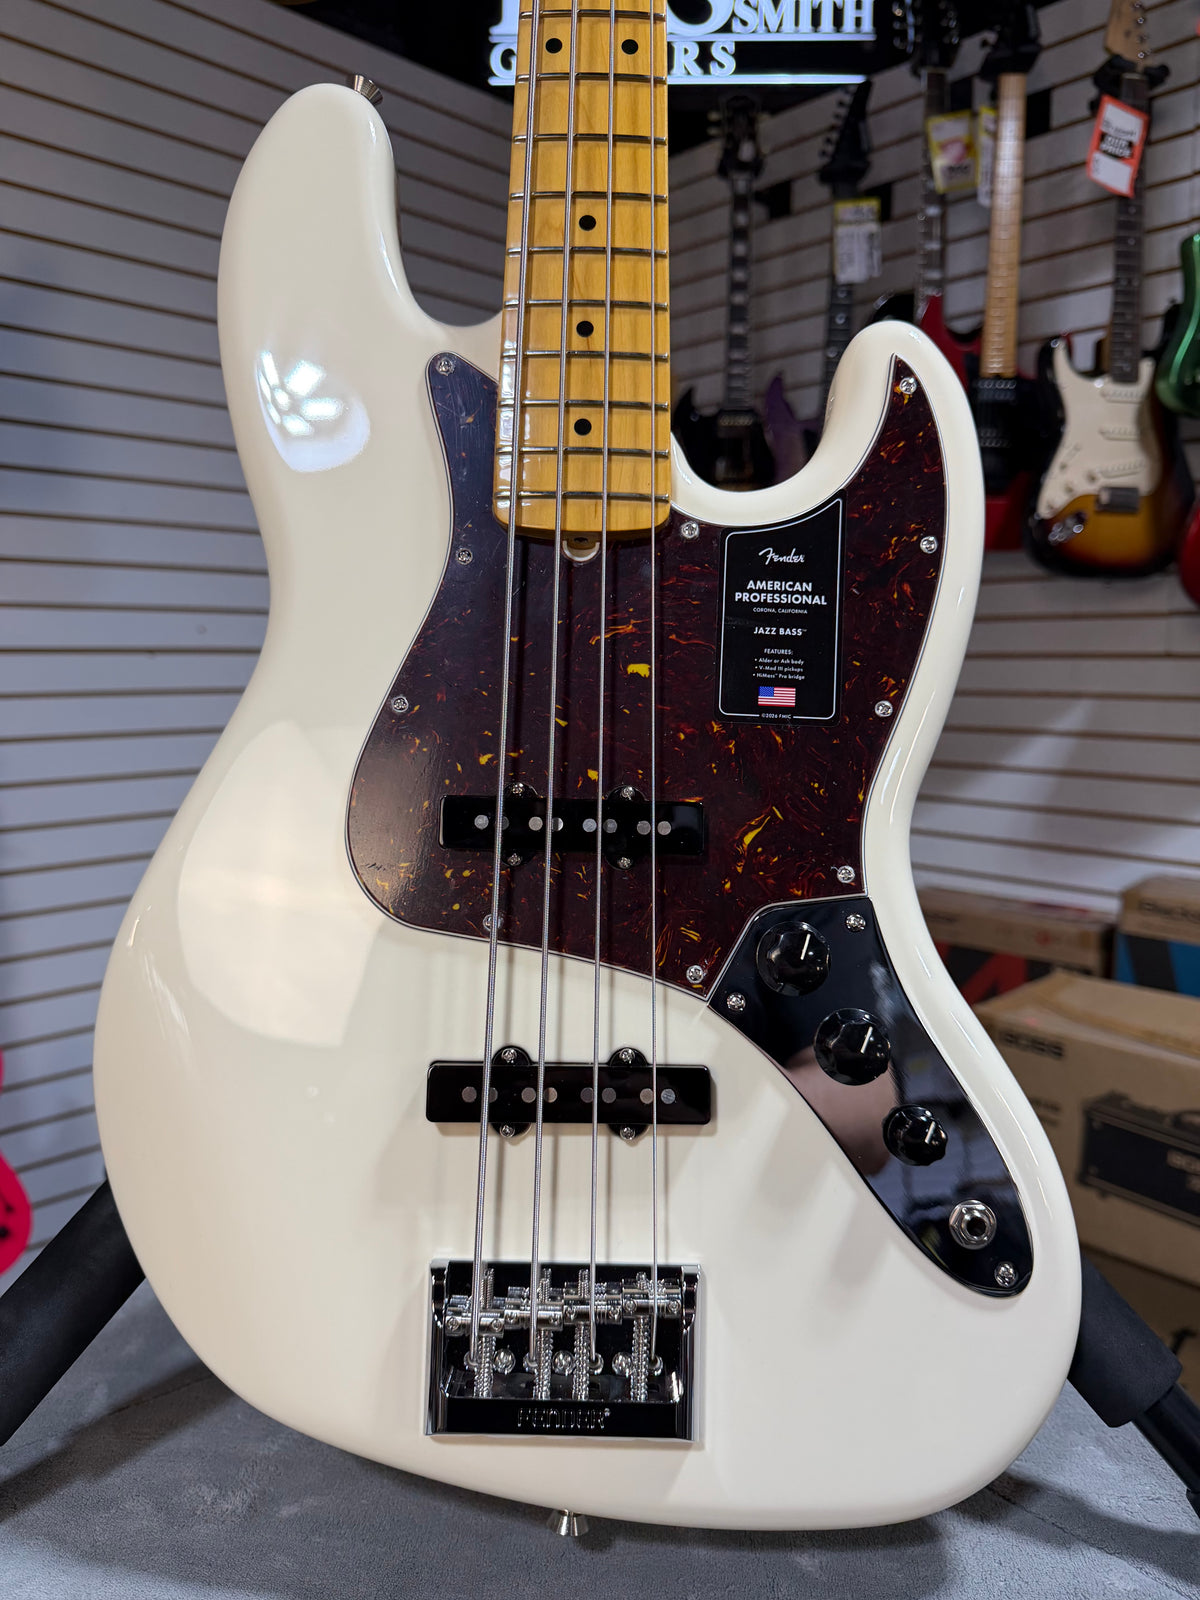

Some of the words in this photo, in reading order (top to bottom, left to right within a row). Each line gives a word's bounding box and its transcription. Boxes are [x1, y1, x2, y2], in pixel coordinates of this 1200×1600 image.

[758, 547, 805, 565] Fender
[746, 579, 813, 592] AMERICAN
[735, 592, 828, 606] PROFESSIONAL
[753, 626, 777, 635] JAZZ
[763, 648, 794, 656] FEATURES:
[791, 658, 805, 666] body
